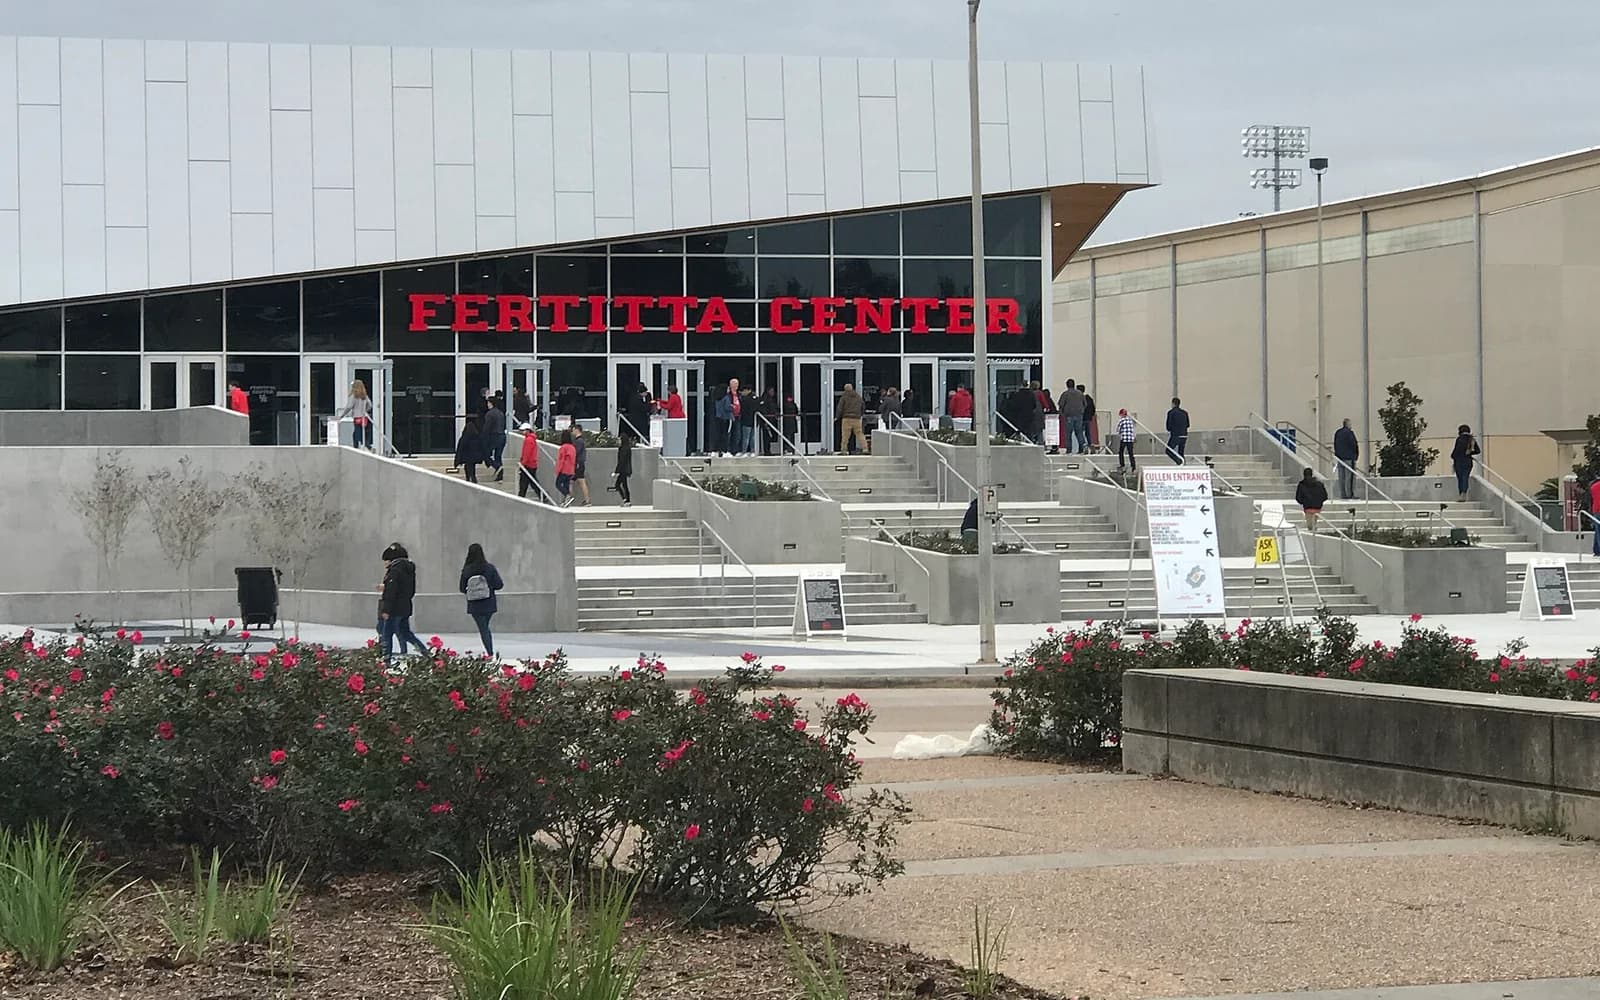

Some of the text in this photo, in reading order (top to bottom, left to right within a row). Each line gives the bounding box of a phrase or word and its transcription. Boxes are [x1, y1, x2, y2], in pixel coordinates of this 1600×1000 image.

[408, 294, 1024, 334] FERTITTA CENTER
[1145, 472, 1211, 481] CULLEN ENTRANCE
[1258, 538, 1273, 550] ASK
[1261, 551, 1271, 562] US
